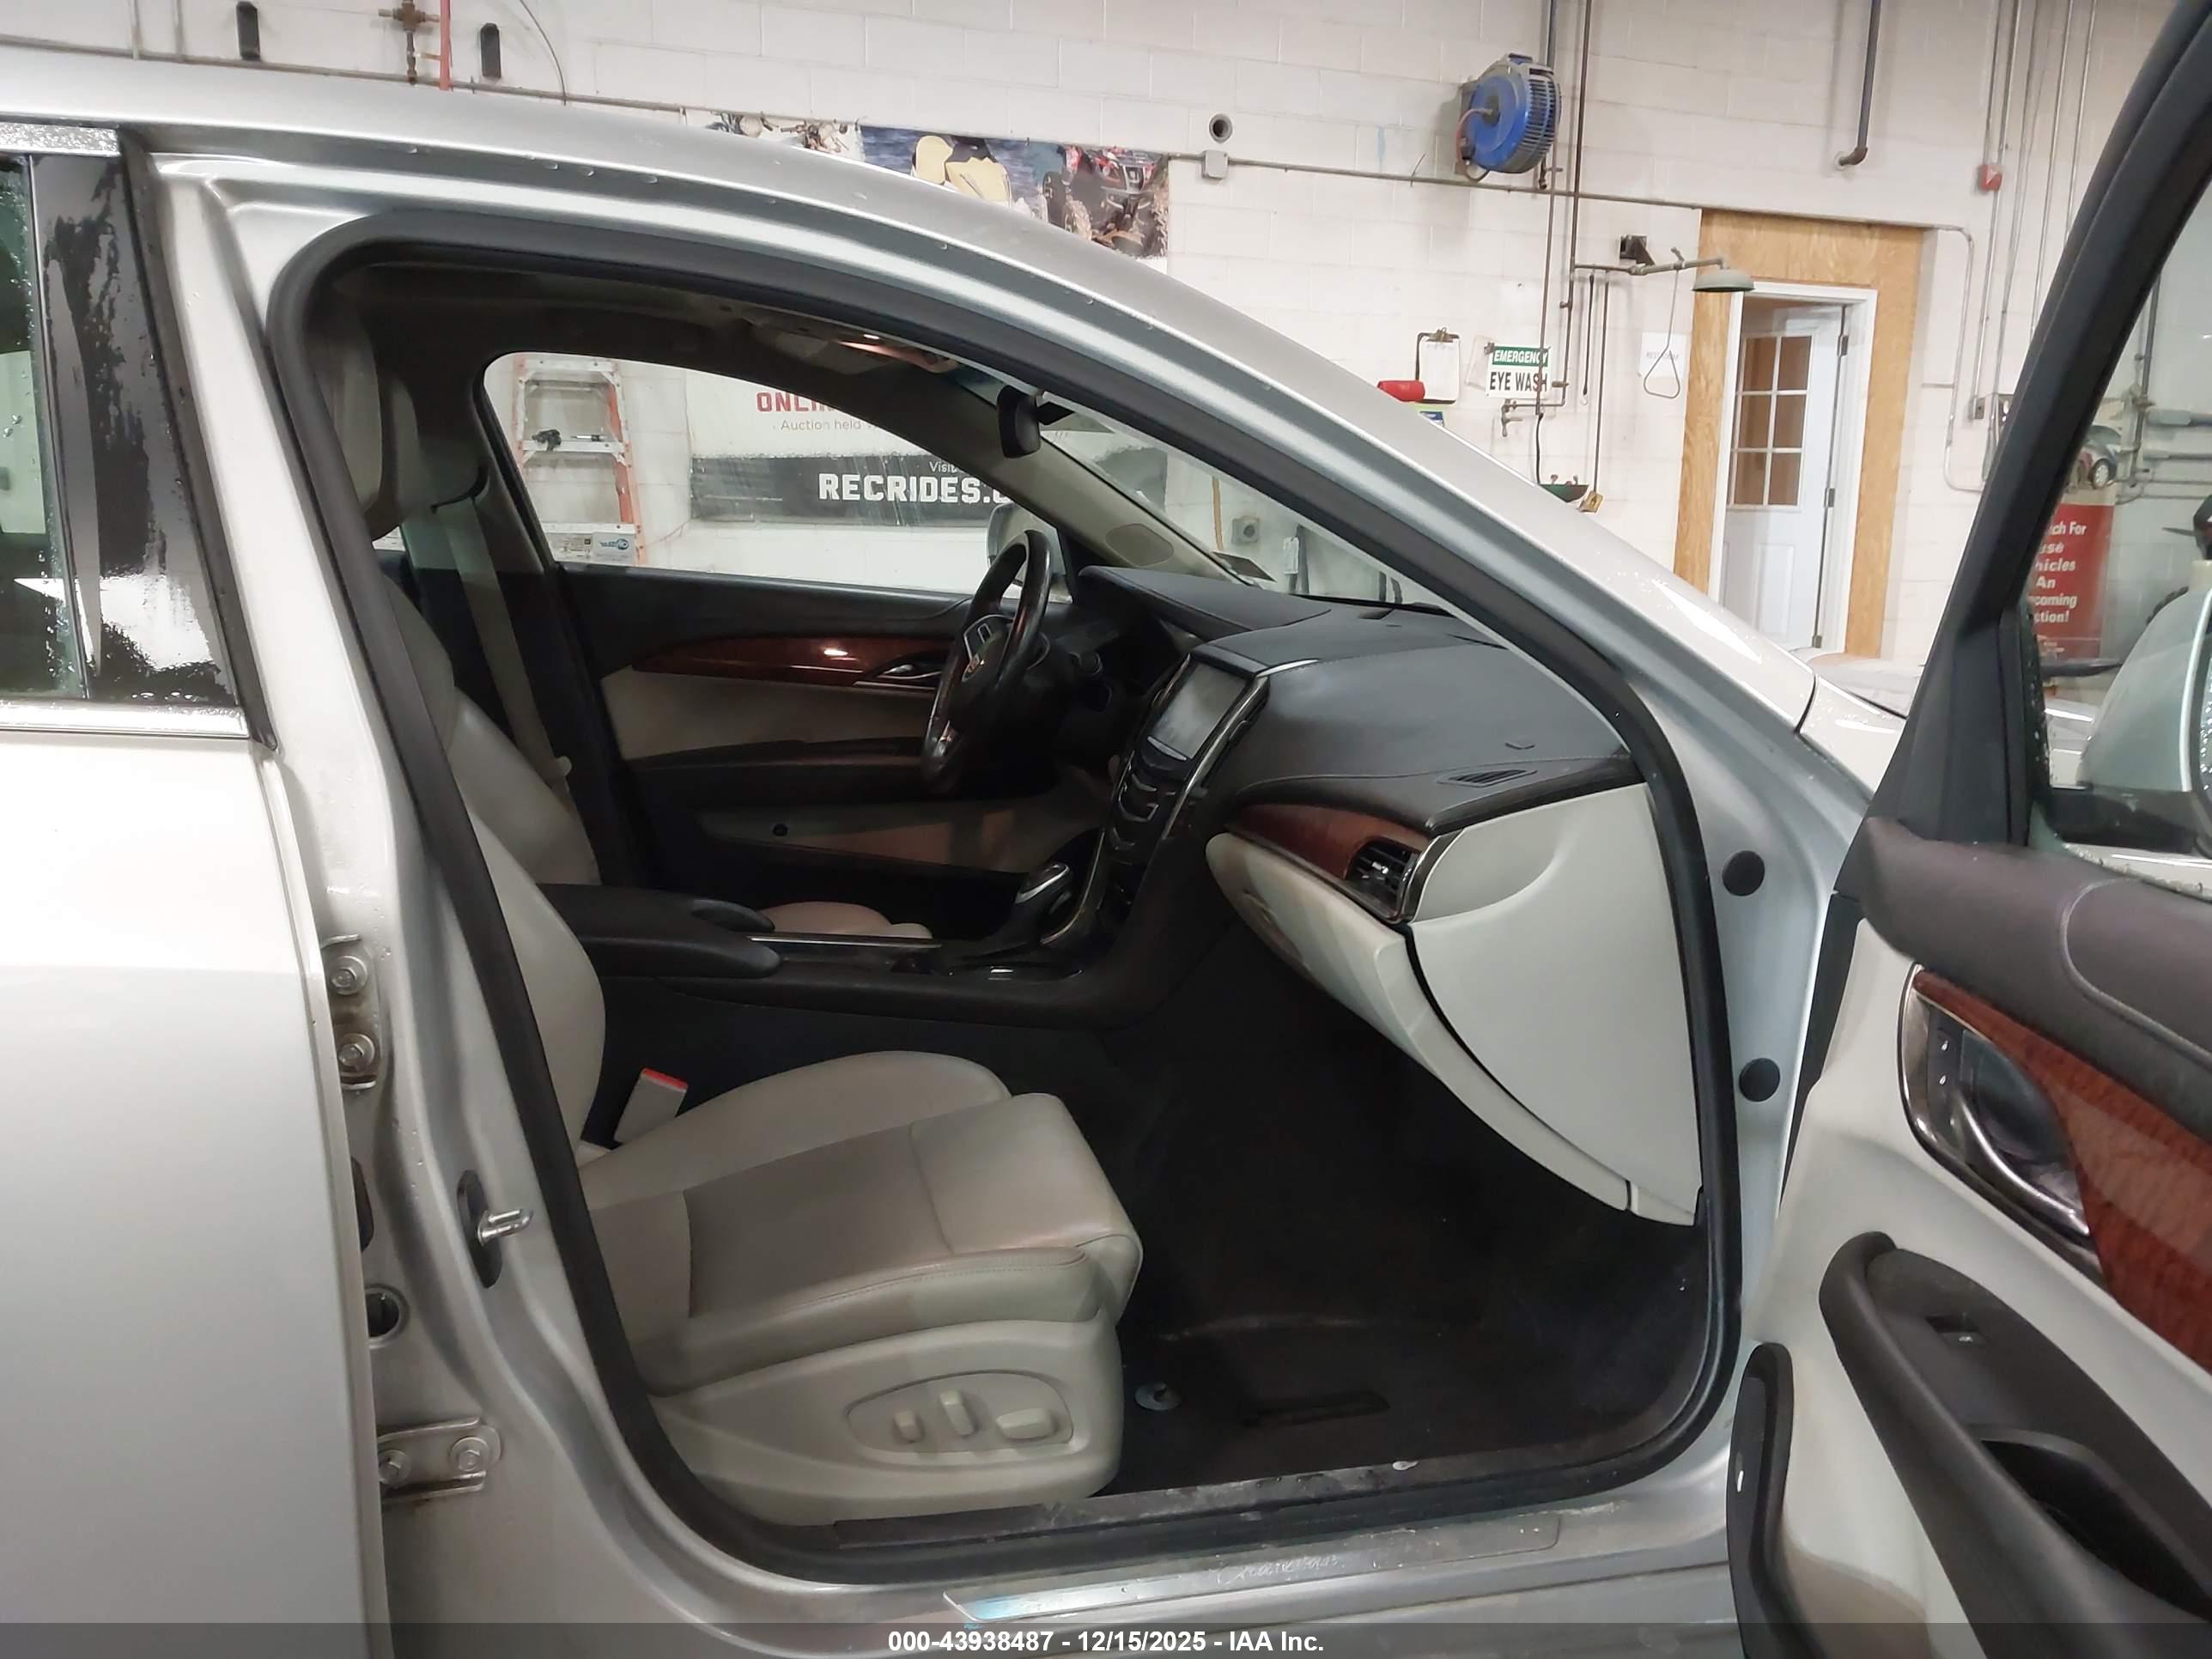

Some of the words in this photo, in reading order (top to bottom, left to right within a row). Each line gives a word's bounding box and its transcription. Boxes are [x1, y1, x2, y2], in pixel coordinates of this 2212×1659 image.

[1493, 349, 1548, 364] EMERGENCY
[1489, 371, 1511, 391] EYE
[1515, 372, 1547, 392] WASH
[781, 419, 830, 431] Auction
[834, 418, 862, 430] held
[2069, 521, 2087, 535] For
[2035, 575, 2057, 589] An
